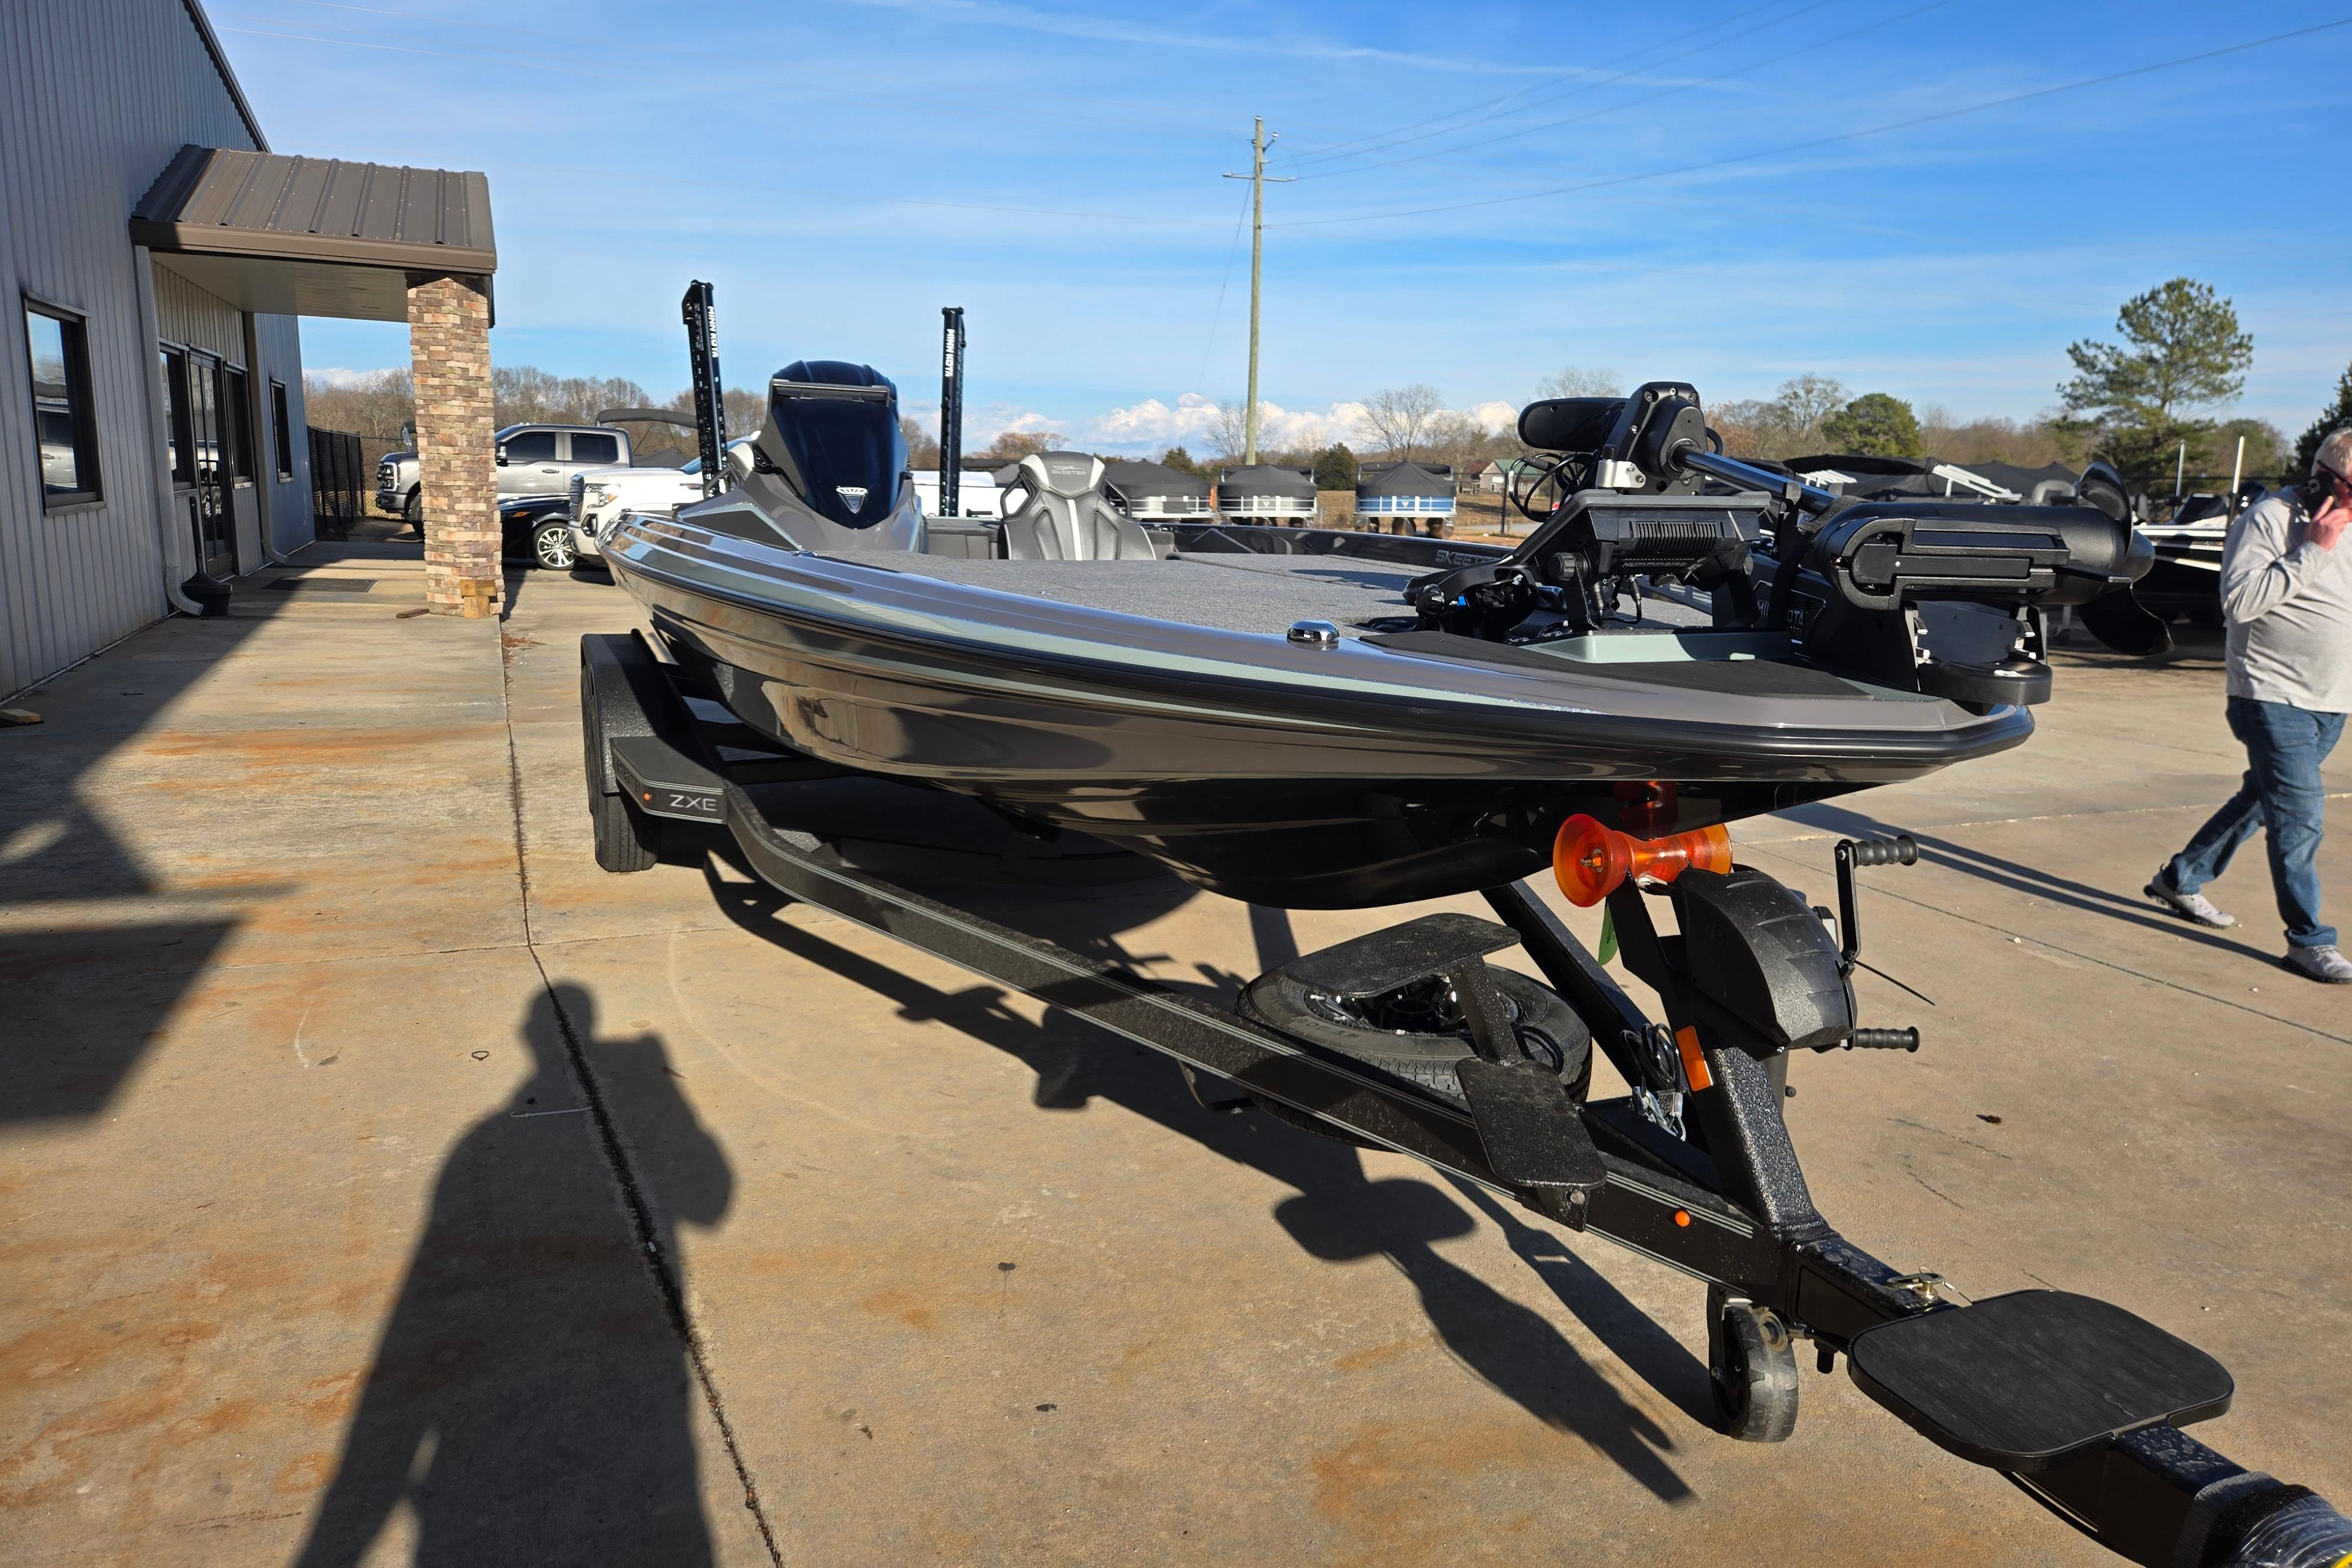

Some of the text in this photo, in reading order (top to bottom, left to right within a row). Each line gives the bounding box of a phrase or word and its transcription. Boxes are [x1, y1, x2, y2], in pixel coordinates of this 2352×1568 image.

[707, 305, 719, 358] MINN KOTA
[944, 329, 956, 377] MINN KOTA
[1435, 549, 1502, 566] SKEETE
[1757, 601, 1804, 626] MI OTA
[669, 794, 717, 811] ZXE
